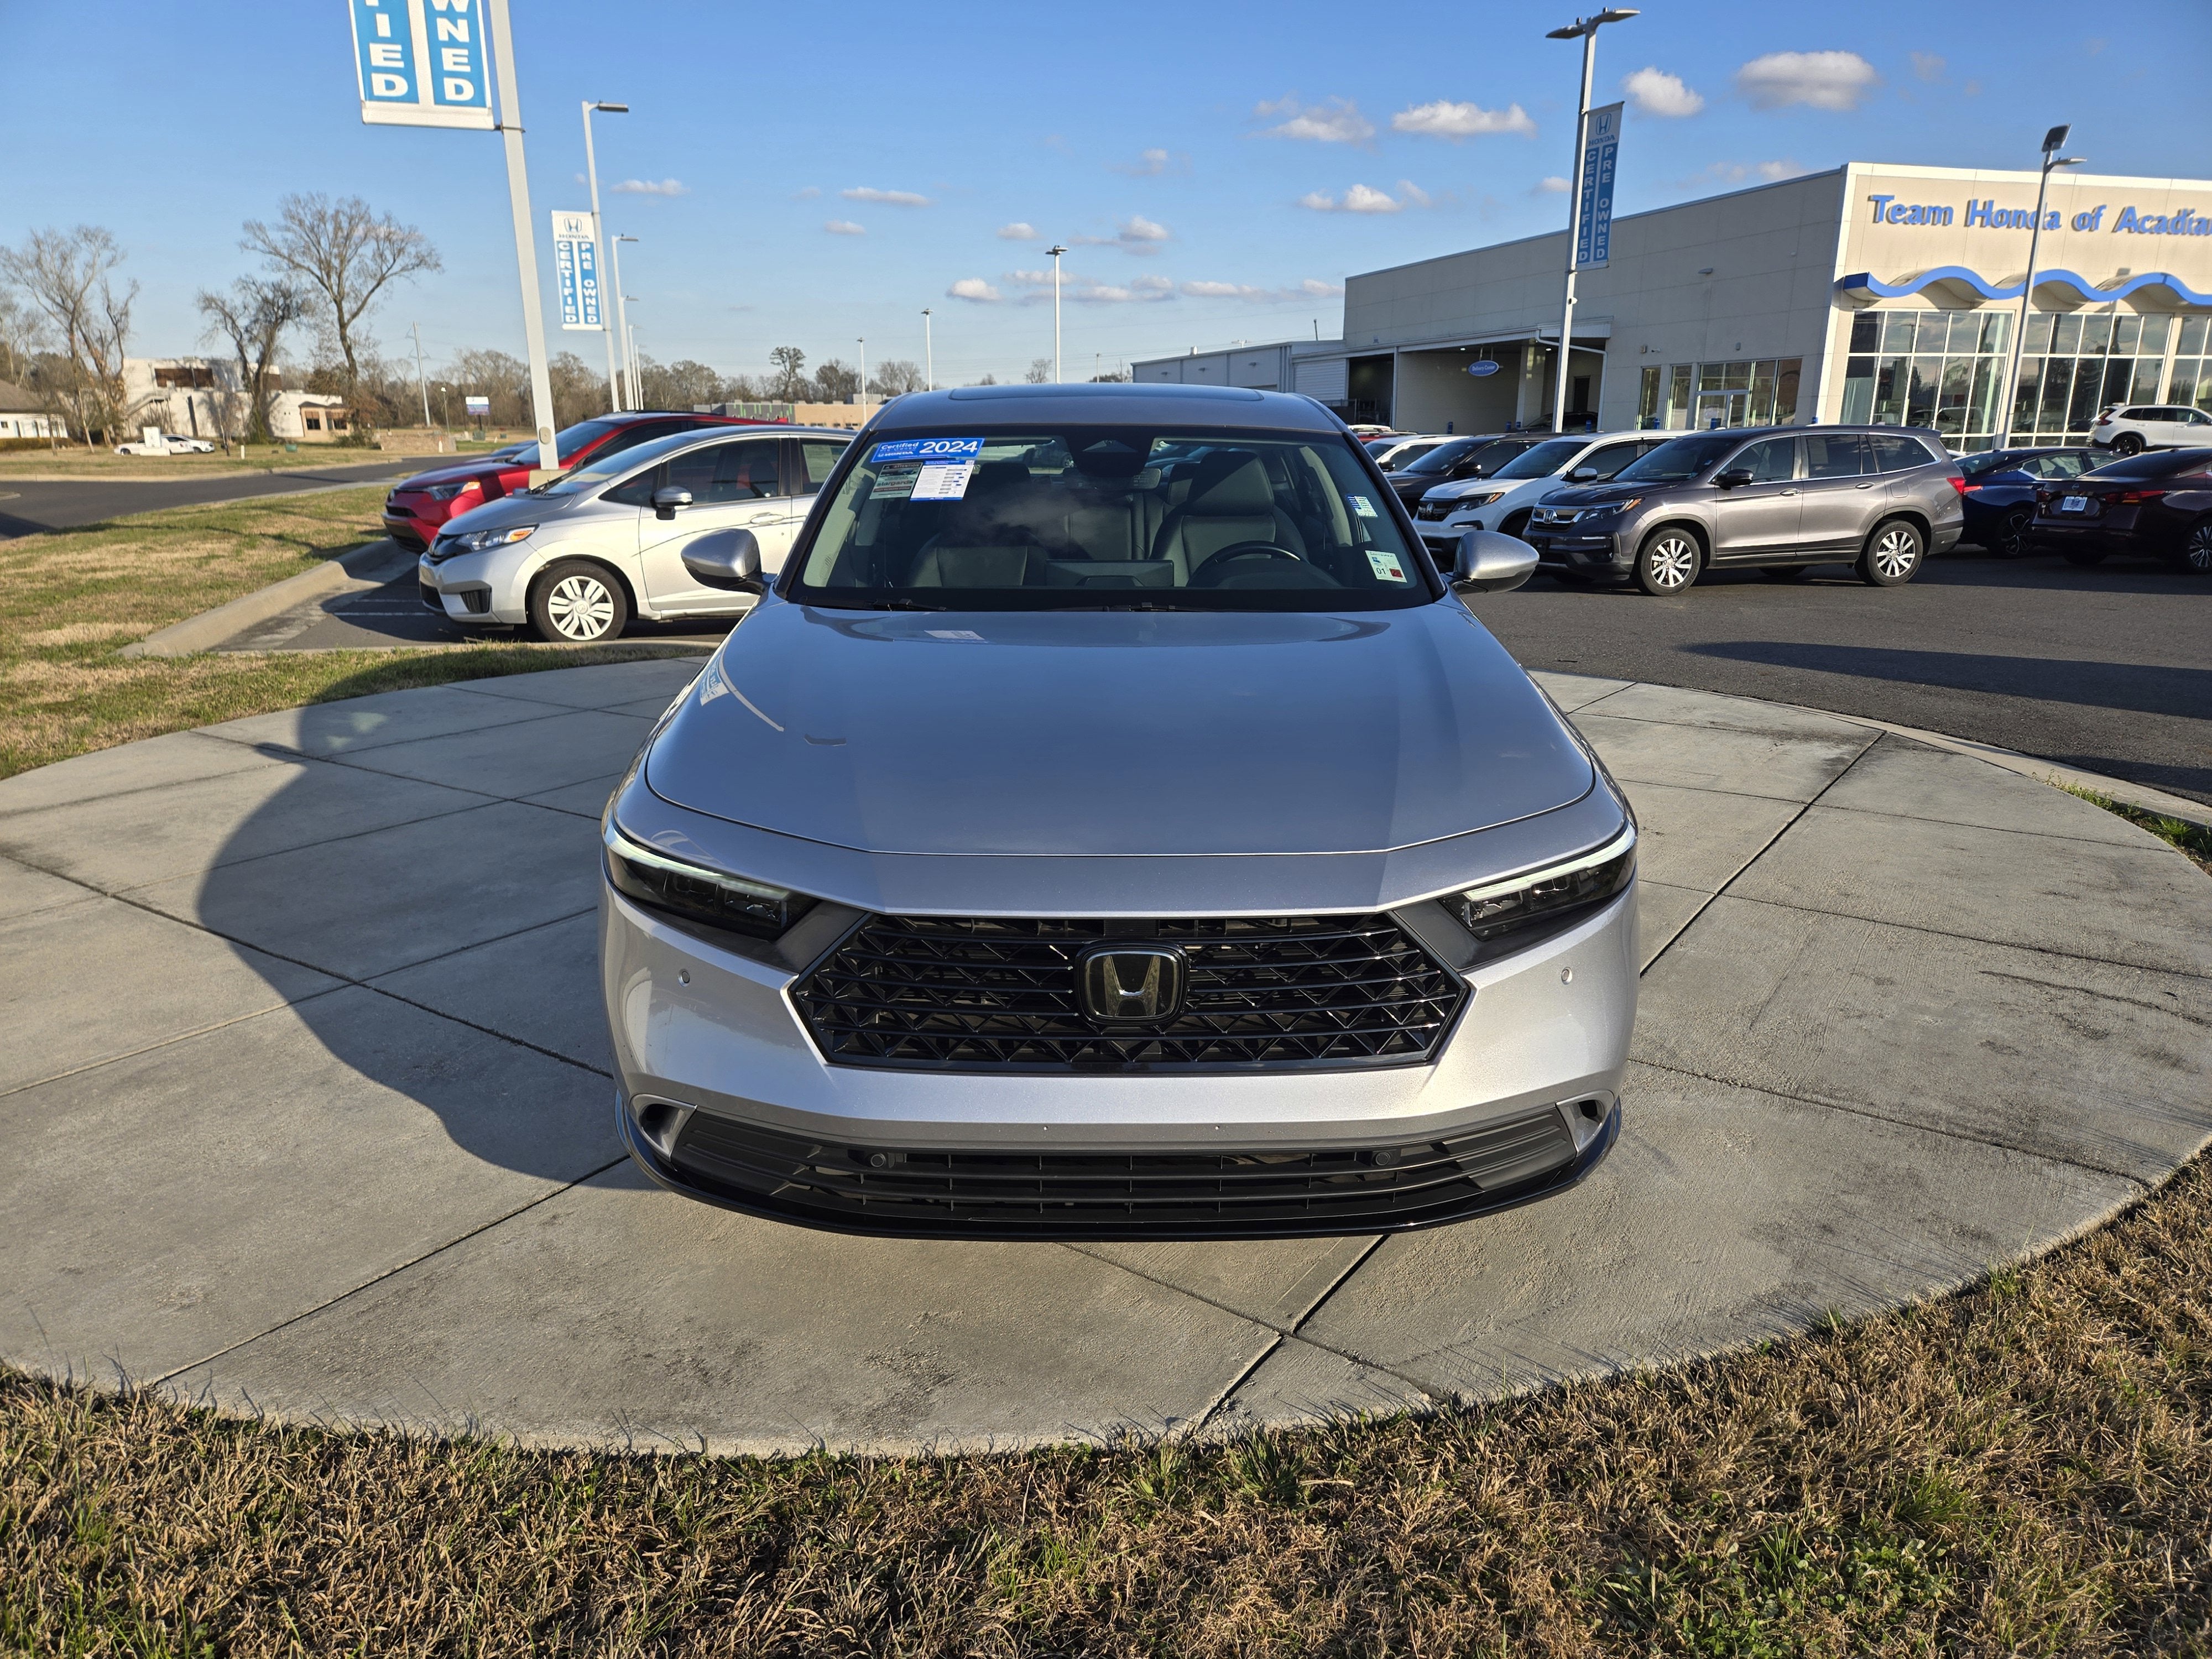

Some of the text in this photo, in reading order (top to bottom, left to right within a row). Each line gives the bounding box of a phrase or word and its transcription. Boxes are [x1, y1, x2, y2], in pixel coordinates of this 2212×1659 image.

[365, 0, 409, 97] IED
[1589, 134, 1615, 146] HONDA
[1578, 151, 1597, 261] CERTIFIED
[1596, 146, 1614, 259] PRE OWNED
[1869, 195, 1954, 225] Team
[2073, 205, 2107, 231] of
[2114, 206, 2212, 236] Acadia
[559, 242, 577, 322] CERTIFIED
[581, 243, 597, 323] PRE OWNED
[919, 441, 978, 453] 2024
